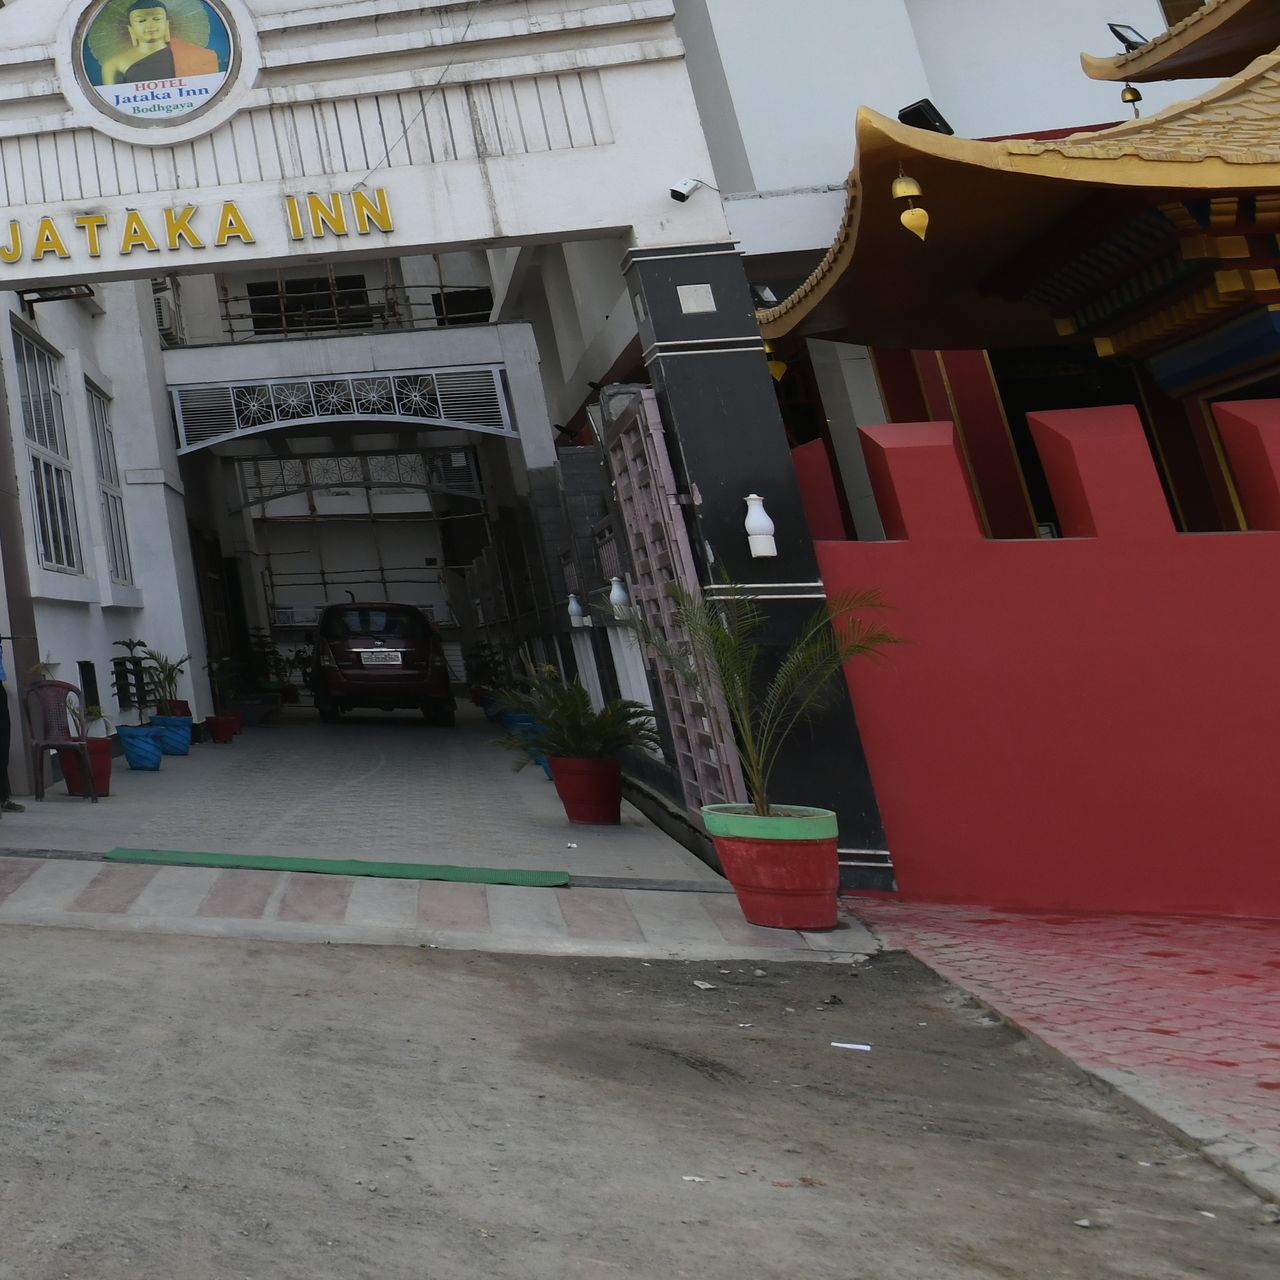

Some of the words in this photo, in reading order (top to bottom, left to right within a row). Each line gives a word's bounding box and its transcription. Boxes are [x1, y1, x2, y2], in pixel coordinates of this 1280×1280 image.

[134, 78, 187, 92] HOTEL
[114, 91, 172, 107] Jataka
[178, 86, 210, 98] Inn
[132, 101, 194, 115] Bodhgaya
[284, 187, 396, 241] INN
